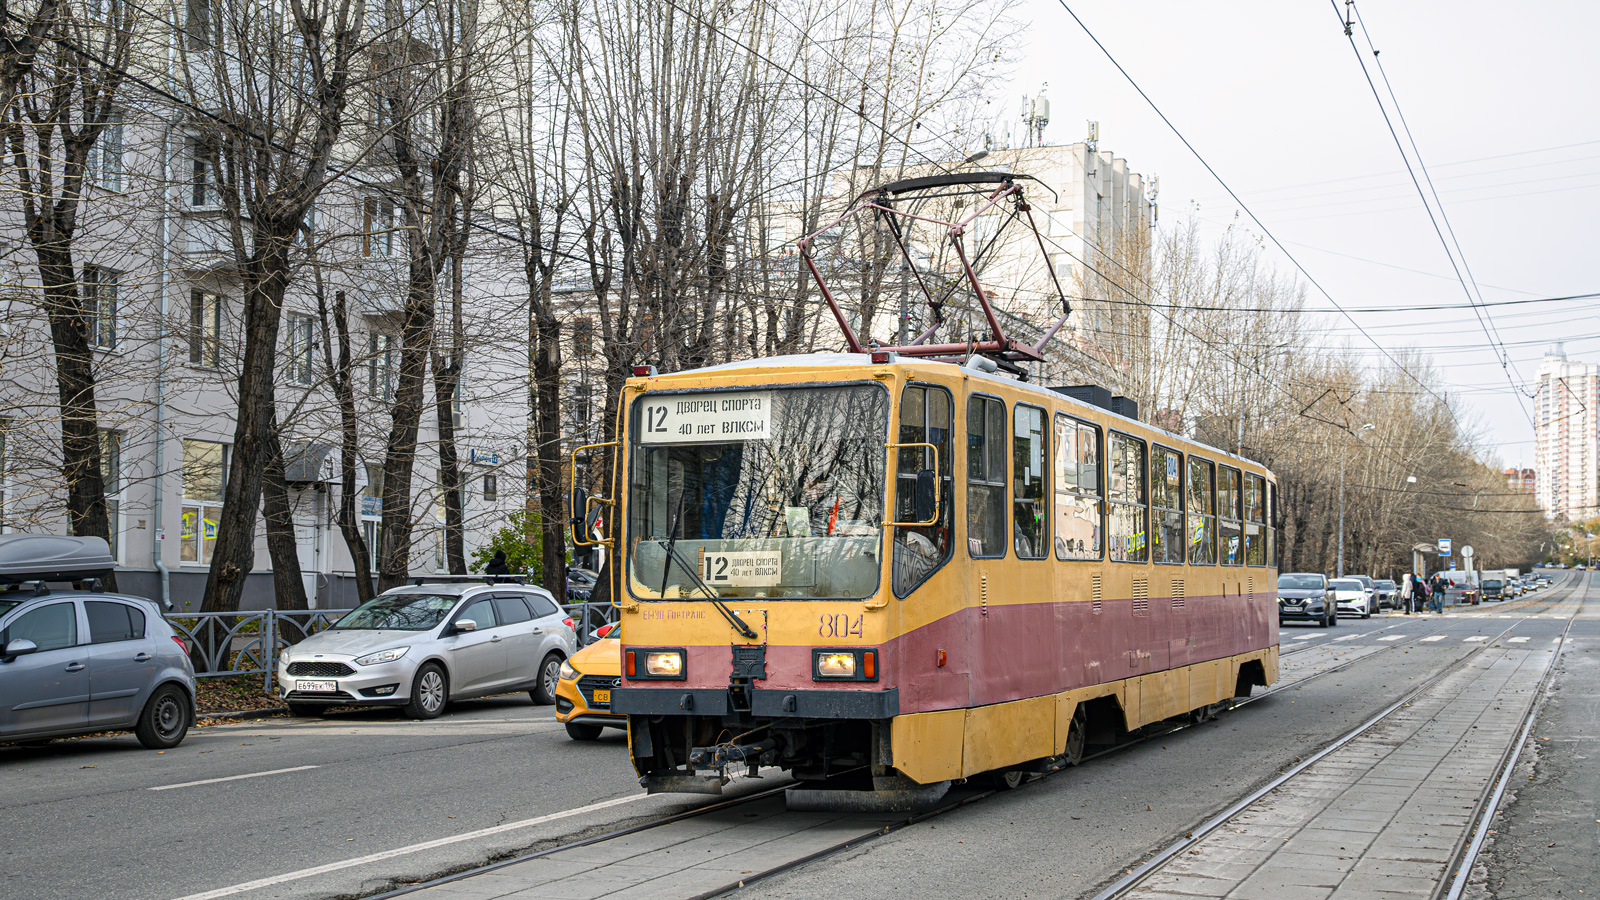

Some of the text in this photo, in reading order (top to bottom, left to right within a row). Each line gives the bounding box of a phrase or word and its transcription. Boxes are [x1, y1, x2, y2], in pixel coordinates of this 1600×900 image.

[647, 406, 668, 433] 12
[678, 420, 764, 435] 40 лет ВЛКСМ
[705, 556, 729, 581] 12
[730, 568, 740, 576] 40
[754, 567, 778, 576] ВЛКСМ
[818, 613, 864, 639] 804
